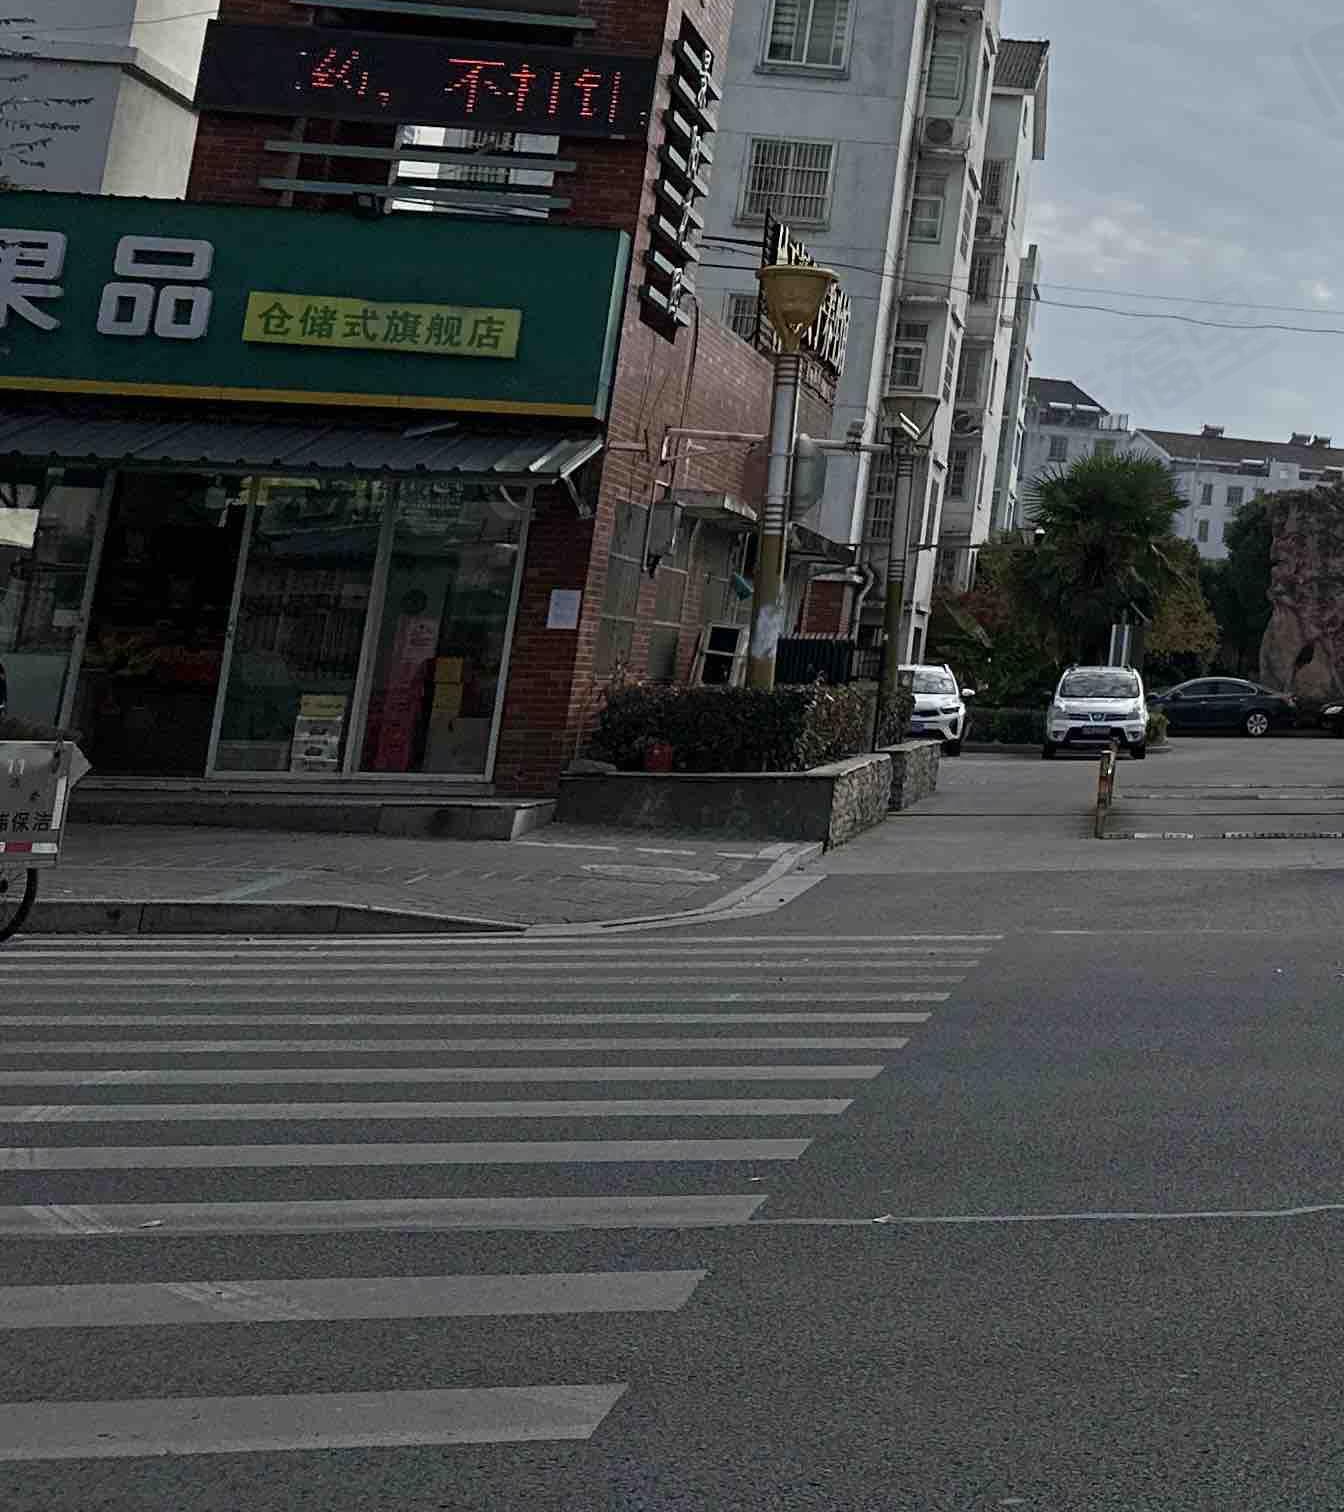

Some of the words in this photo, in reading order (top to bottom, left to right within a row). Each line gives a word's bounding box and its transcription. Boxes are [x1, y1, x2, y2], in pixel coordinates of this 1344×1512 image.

[257, 302, 506, 351] 仓储式旗舰店
